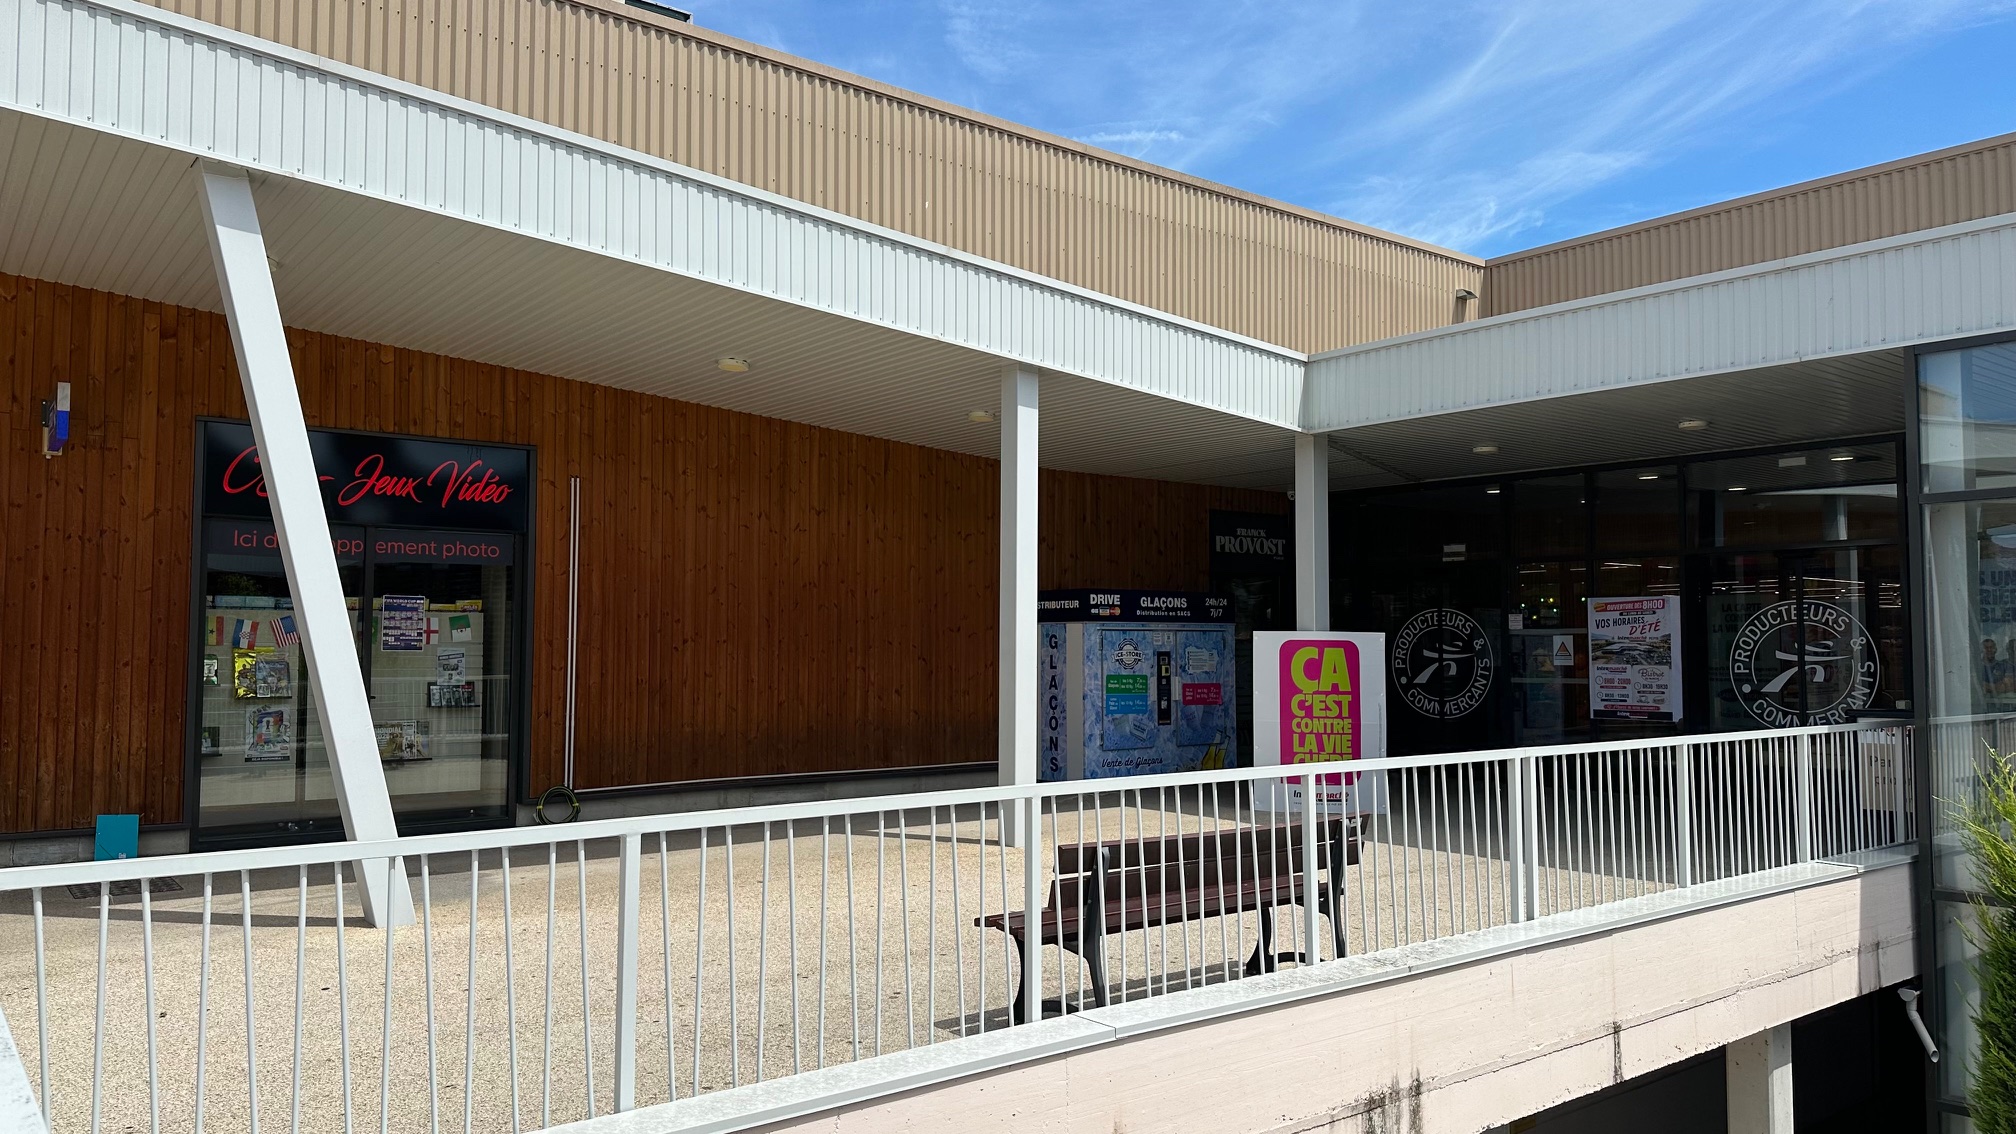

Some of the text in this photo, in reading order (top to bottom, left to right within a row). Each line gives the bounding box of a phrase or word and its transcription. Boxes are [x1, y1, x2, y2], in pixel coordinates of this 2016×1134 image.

[338, 454, 423, 506] Jeux
[427, 459, 513, 508] Vidéo
[1236, 528, 1266, 537] FRANCK
[234, 530, 257, 547] Ici
[443, 541, 499, 559] photo
[1216, 536, 1285, 555] PROVOST
[1037, 600, 1079, 609] STRIBUTEUR
[1090, 594, 1120, 605] DRIVE
[1140, 597, 1187, 610] GLAÇONS
[1205, 598, 1227, 607] 24h/24
[1642, 600, 1663, 610] 8H00
[1210, 609, 1222, 618] 7j/7
[1595, 617, 1645, 629] VOS HORAIRES
[1629, 618, 1661, 635] D'ÉTÉ
[1734, 604, 1850, 674] PRODUCTEURS
[1850, 636, 1867, 651] &
[1291, 646, 1351, 693] ÇA
[1395, 612, 1490, 715] PRODUCTEURS & COMMERÇANTS
[1049, 634, 1059, 772] GLAÇONS
[1291, 694, 1351, 717] C'EST
[1292, 717, 1351, 733] CONTRE
[1293, 734, 1352, 753] LA VIE
[1102, 756, 1163, 768] Vente de Glaçons
